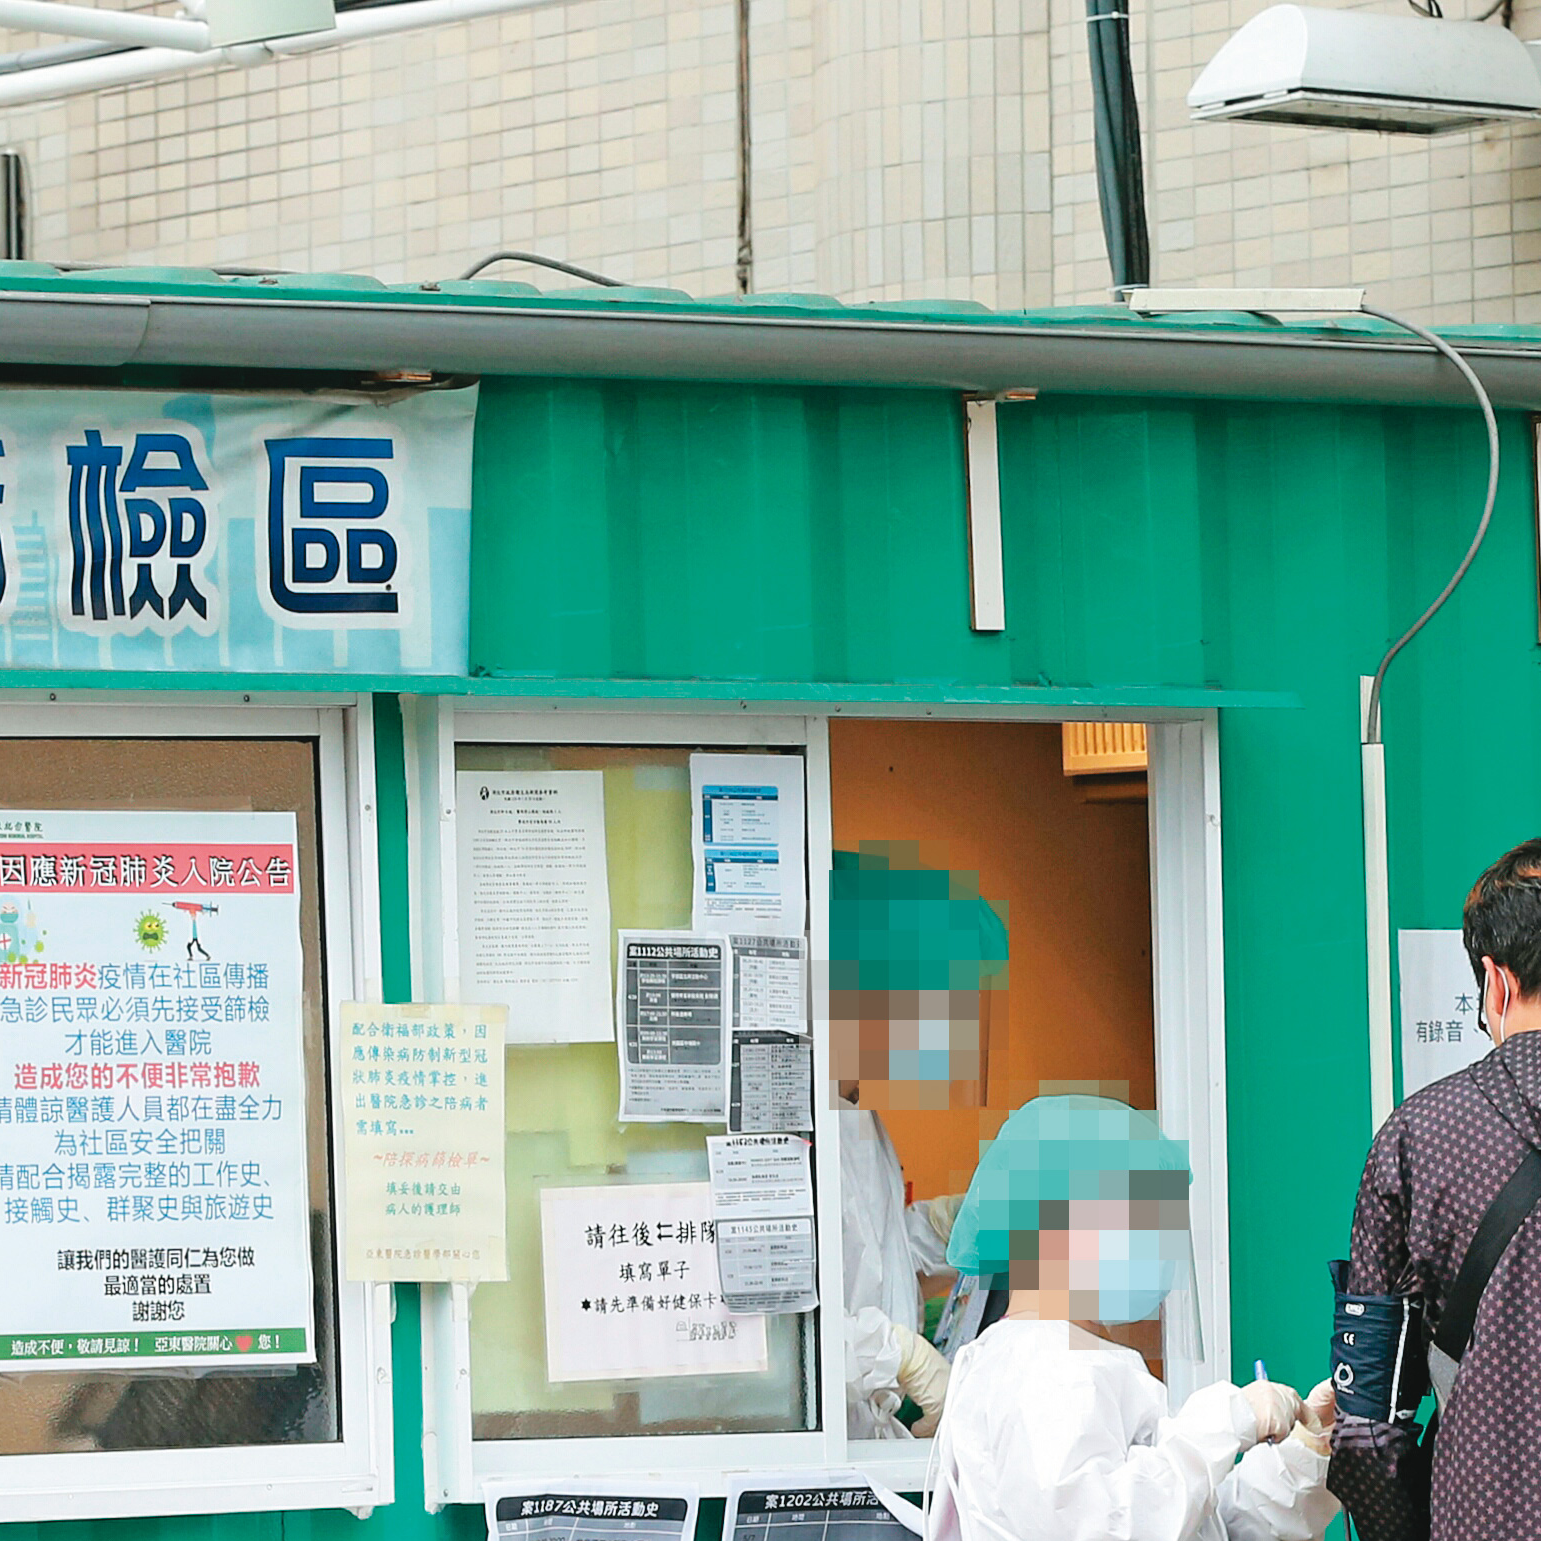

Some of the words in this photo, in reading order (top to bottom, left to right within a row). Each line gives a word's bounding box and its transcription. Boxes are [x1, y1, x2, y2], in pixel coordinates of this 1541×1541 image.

[0, 995, 270, 1024] 急診民眾必須先接受篩檢
[64, 1028, 213, 1056] 才能進入醫院
[14, 1061, 261, 1090] 造成您的不便非常抱歉
[355, 1092, 489, 1112] 出醫院急診之陪病者
[53, 1127, 226, 1157] 為社區安全把關
[386, 1181, 462, 1197] 填妥後請交由
[385, 1202, 462, 1217] 病人的護理師
[57, 1247, 256, 1271] 讓我們的醫護同仁為您做
[619, 1260, 690, 1283] 填寫單子
[103, 1274, 213, 1297] 最適當的處置
[132, 1300, 186, 1322] 謝謝您
[594, 1291, 717, 1314] 請先準備好健保卡
[521, 1499, 660, 1518] 案1187公共場所活動史
